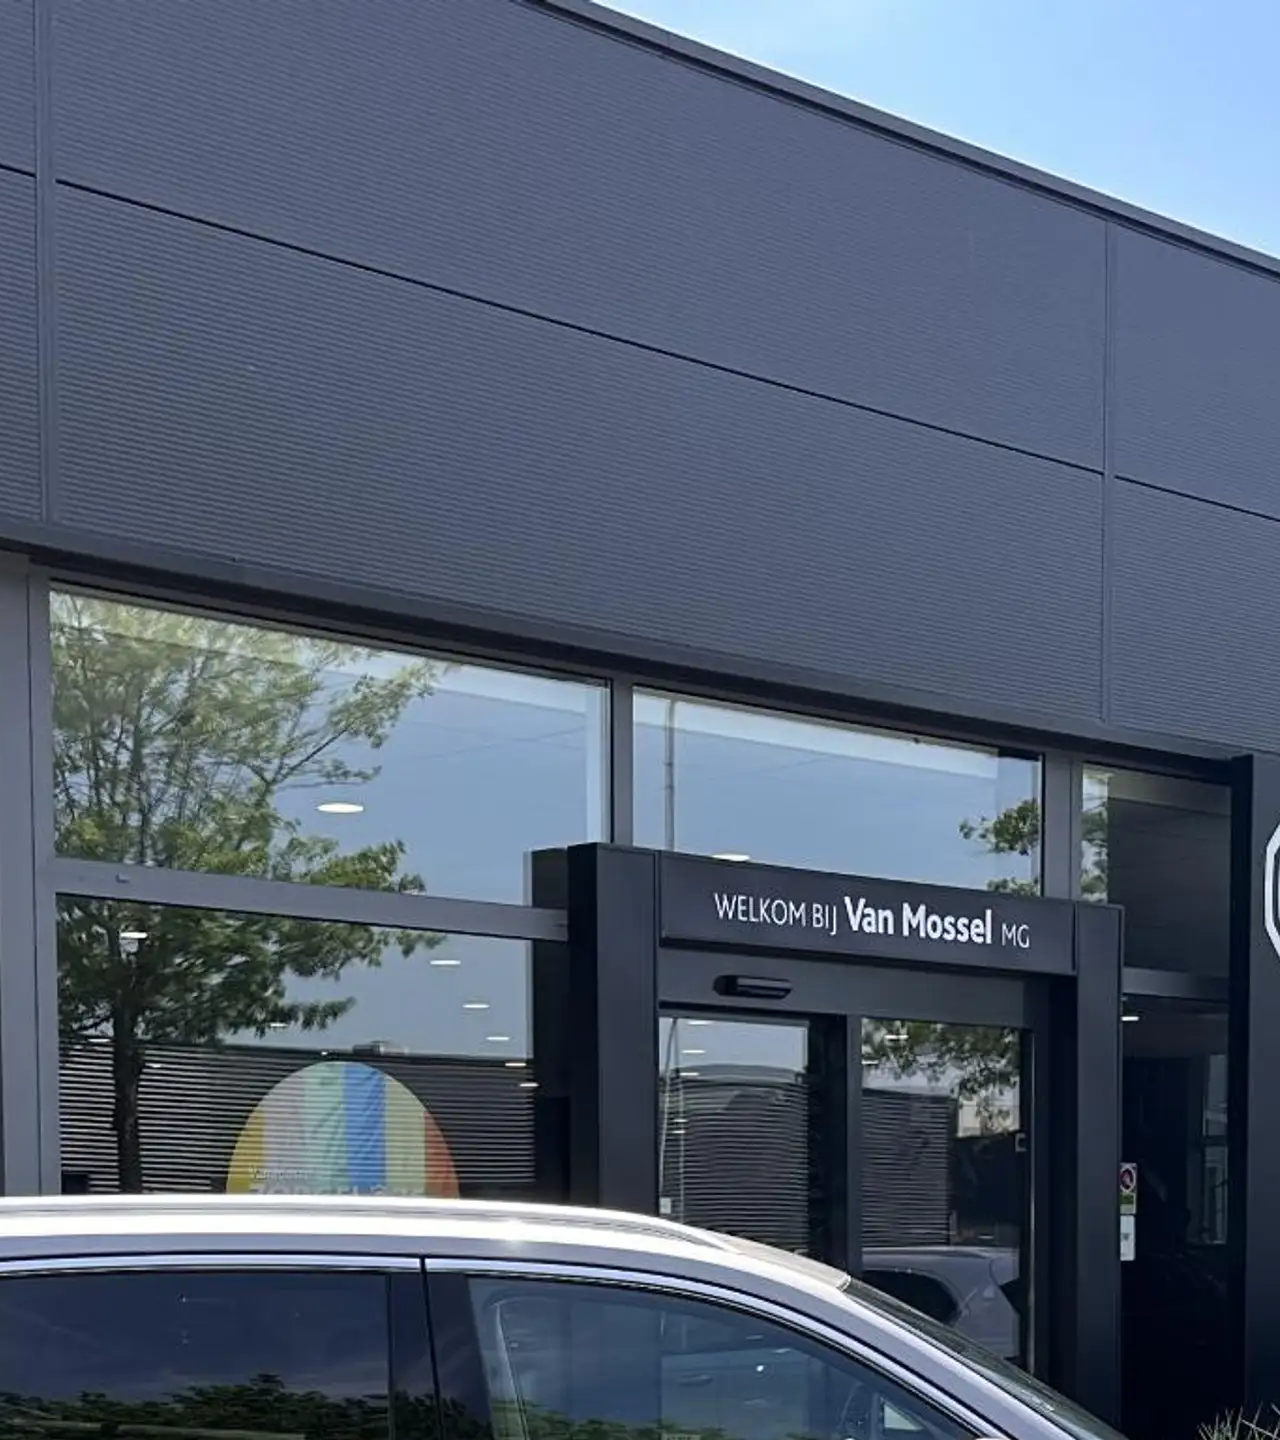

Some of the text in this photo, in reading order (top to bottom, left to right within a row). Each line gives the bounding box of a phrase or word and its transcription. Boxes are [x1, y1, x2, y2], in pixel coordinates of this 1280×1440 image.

[713, 891, 1030, 949] WELKOM BIJ Van Mossel MG
